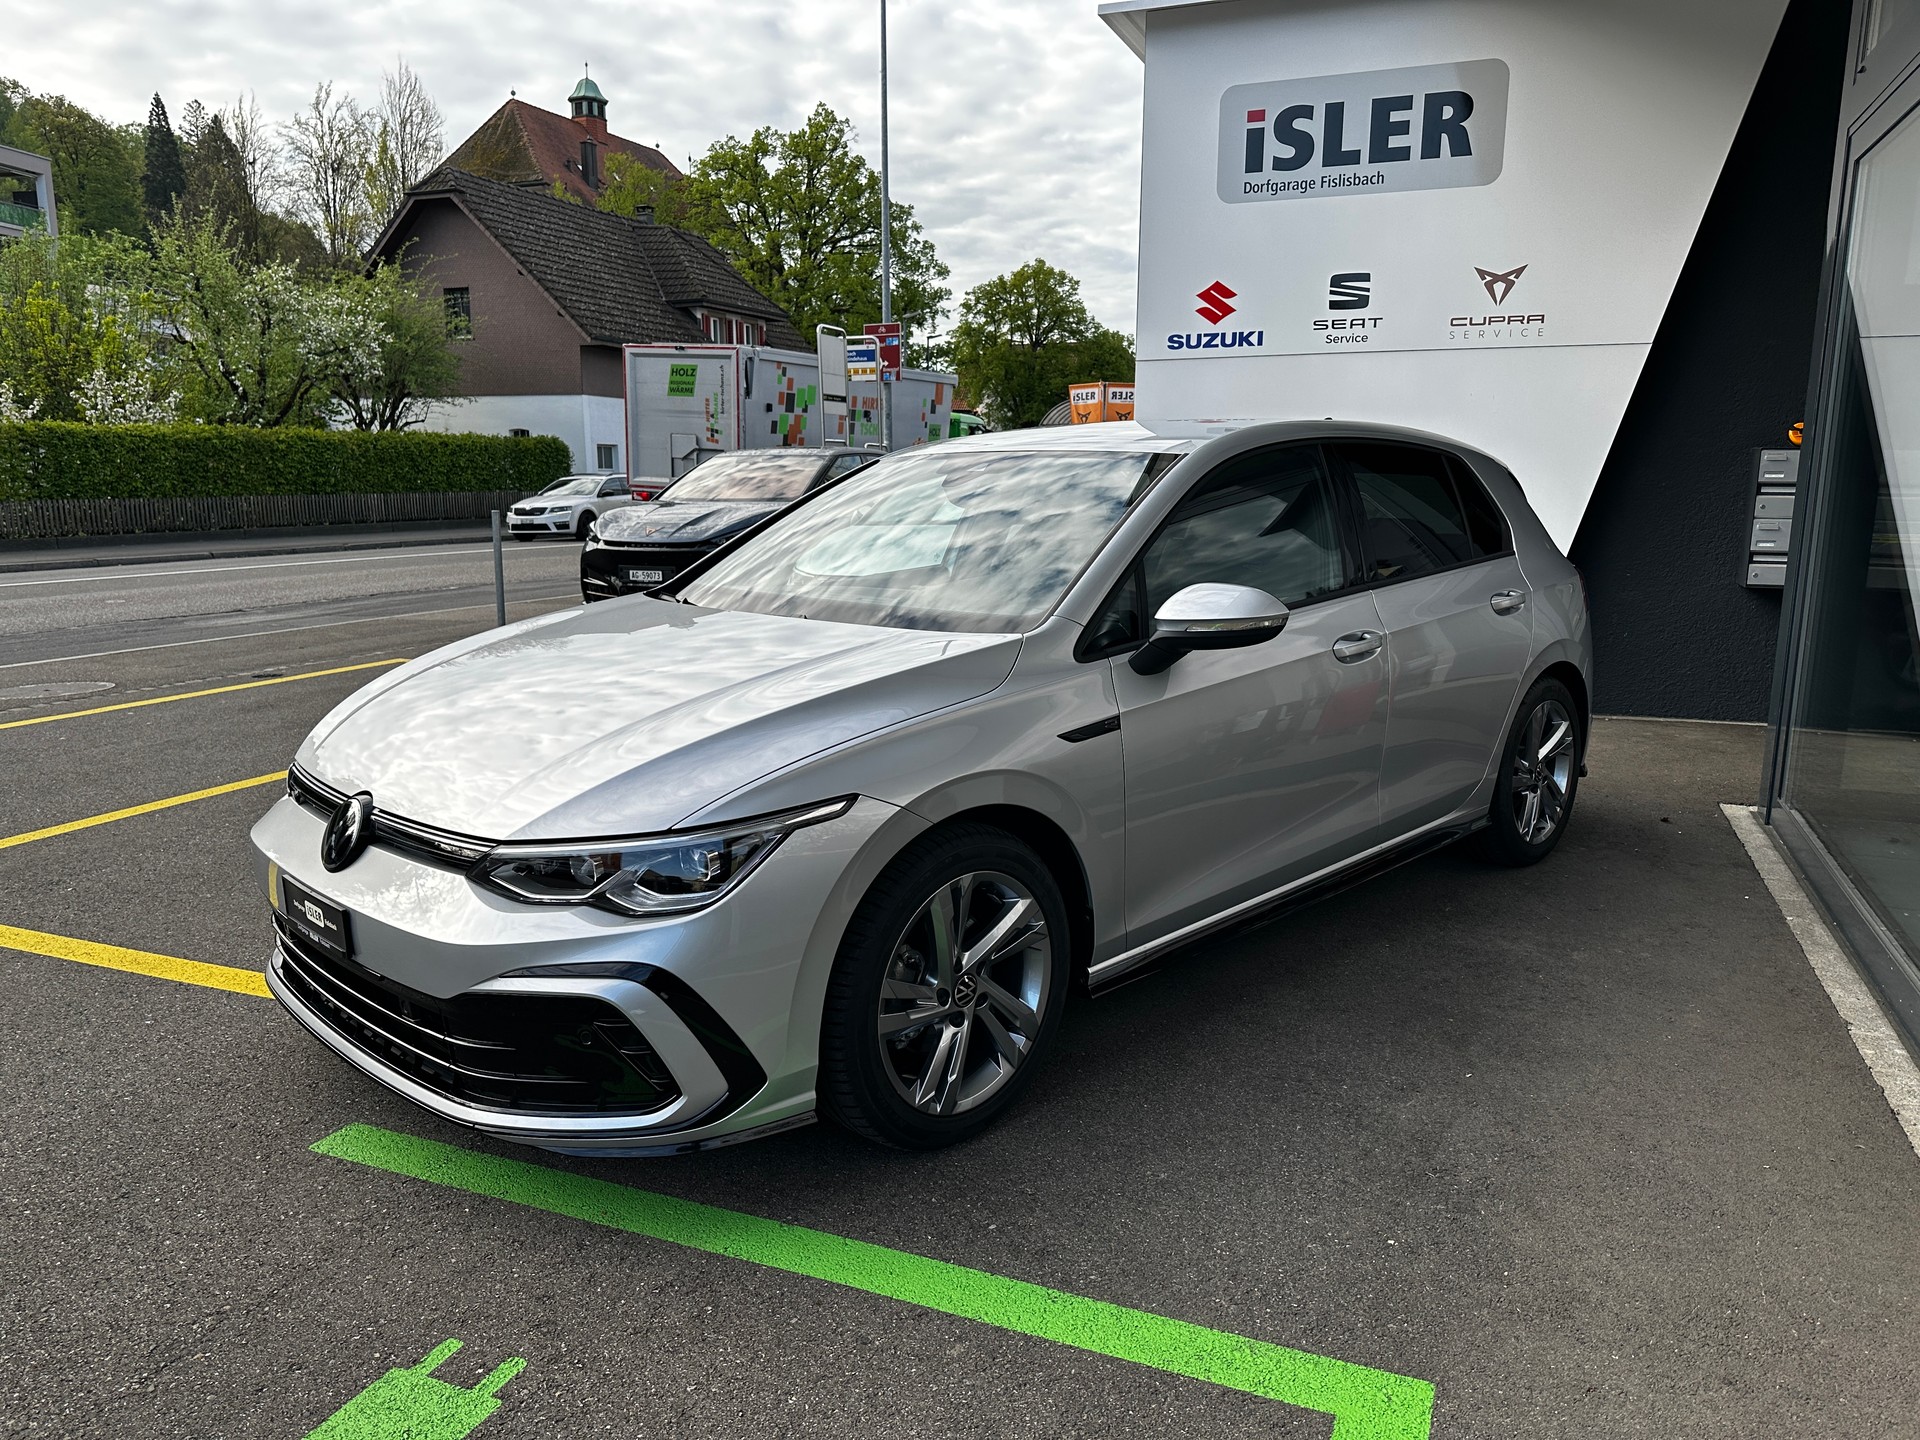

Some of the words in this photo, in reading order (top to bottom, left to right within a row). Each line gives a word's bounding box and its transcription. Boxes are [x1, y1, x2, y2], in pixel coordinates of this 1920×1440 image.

[1243, 178, 1316, 196] Dorfgarage
[1320, 170, 1385, 189] Fislisbach
[1312, 316, 1384, 331] SEAT
[1449, 313, 1546, 328] CUPRA
[1166, 330, 1264, 350] SUZUKI
[1325, 332, 1369, 344] Service
[1449, 327, 1545, 341] SERVICE
[671, 367, 696, 377] HOLZ
[861, 422, 879, 436] TSCH
